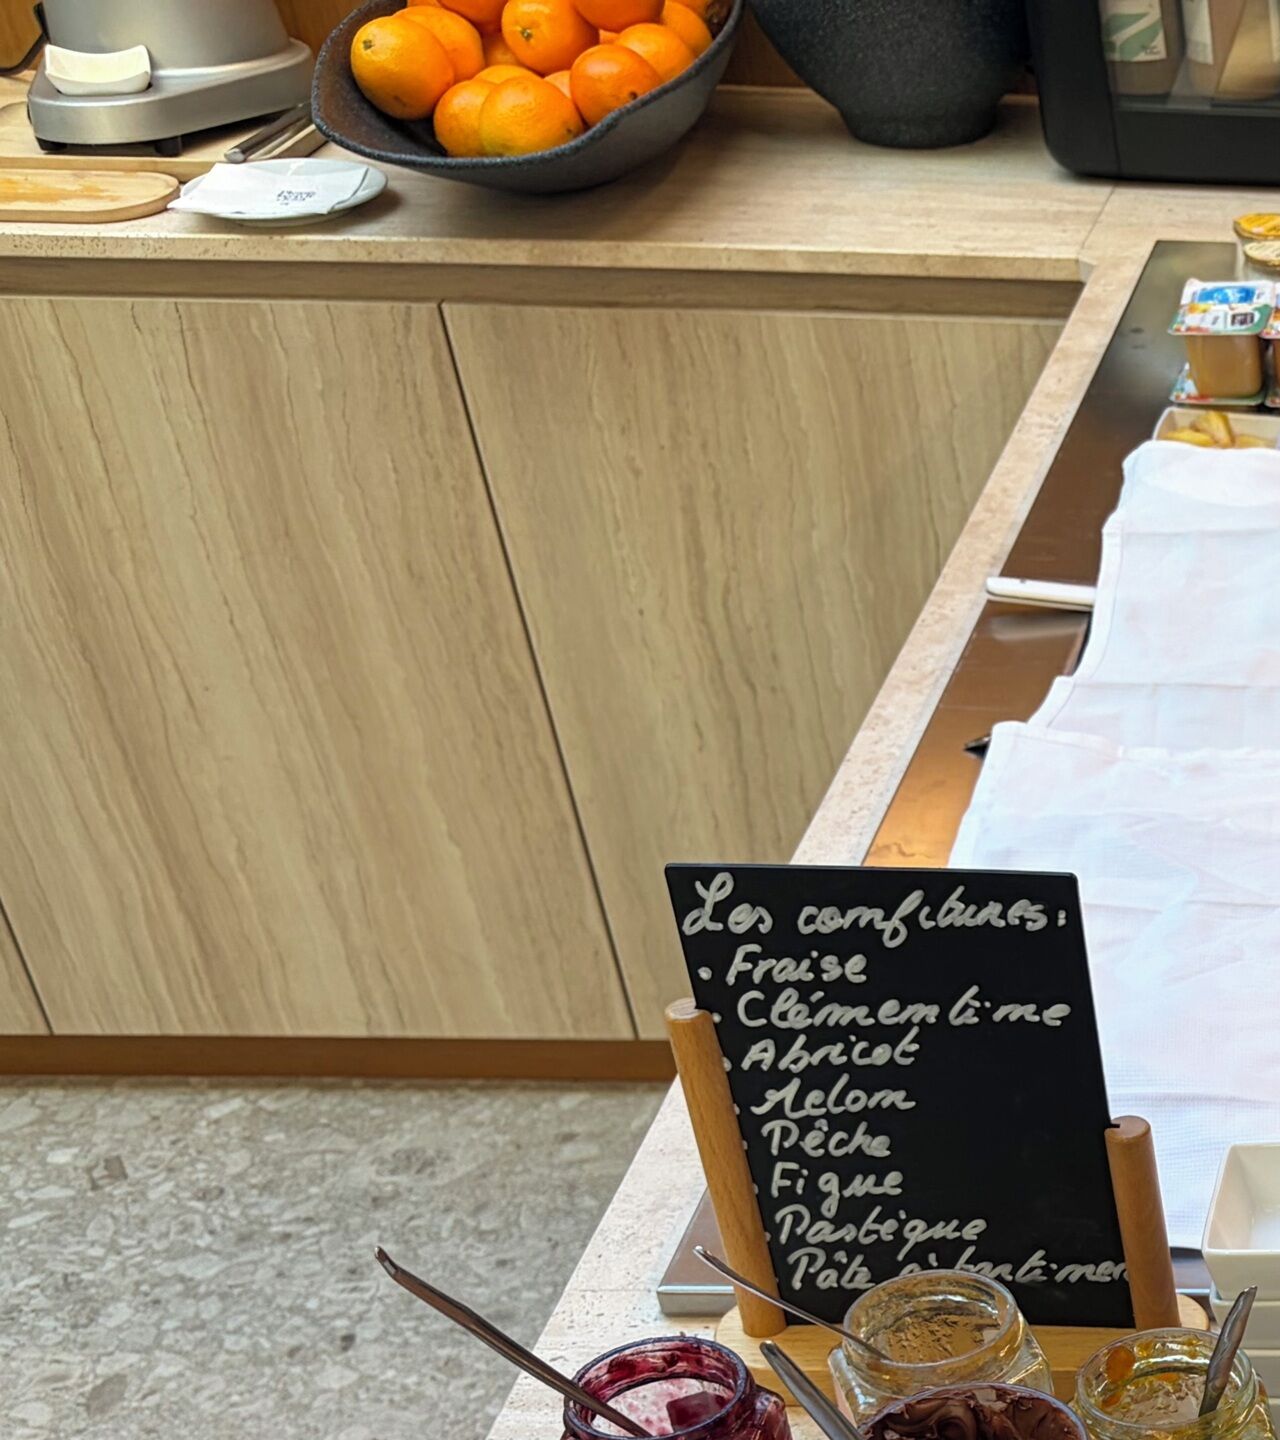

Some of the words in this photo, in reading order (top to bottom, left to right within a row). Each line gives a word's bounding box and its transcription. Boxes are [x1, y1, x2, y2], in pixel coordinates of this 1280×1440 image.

[682, 871, 774, 935] Les
[725, 944, 868, 986] Fraise
[737, 985, 1072, 1029] Clémentine
[741, 1026, 920, 1074] Abricot
[761, 1118, 892, 1159] Pêche
[770, 1162, 903, 1218] Figue
[786, 1245, 876, 1291] Pâte
